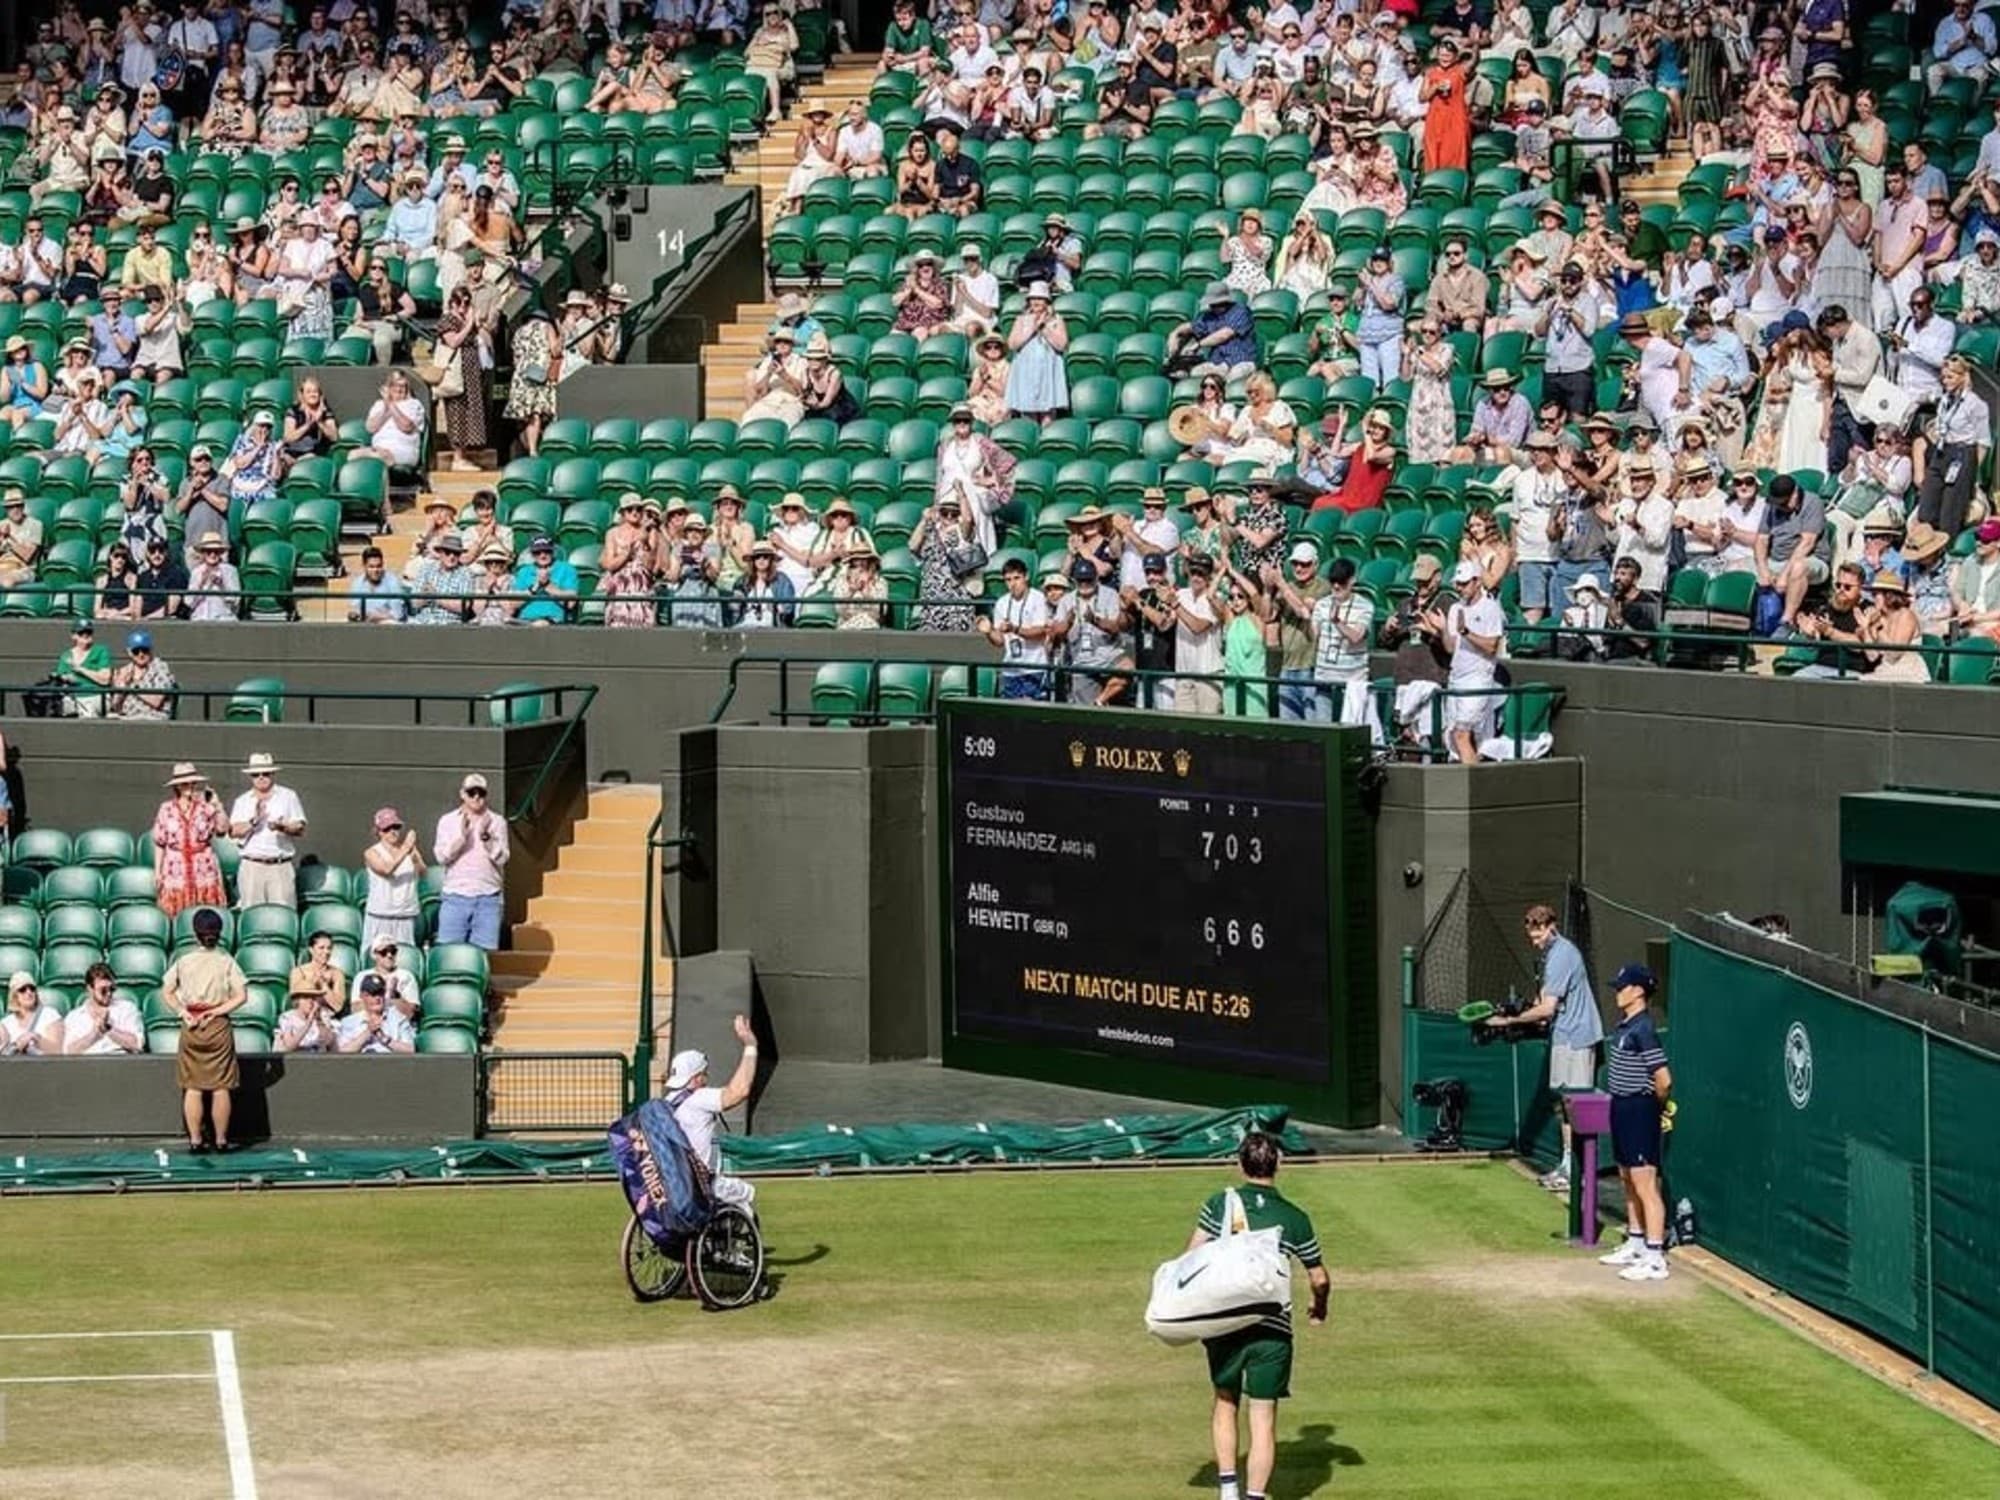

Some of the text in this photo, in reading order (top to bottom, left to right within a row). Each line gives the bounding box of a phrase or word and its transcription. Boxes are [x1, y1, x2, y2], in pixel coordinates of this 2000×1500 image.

[657, 229, 684, 256] 14
[964, 736, 996, 757] 5:09
[1095, 746, 1165, 773] ROLEX
[966, 801, 1025, 824] Gustavo
[1228, 804, 1235, 816] 2
[966, 826, 1057, 853] FERNANDEZ
[1201, 831, 1215, 858] 7
[1226, 833, 1239, 860] 0
[1249, 837, 1262, 864] 3
[967, 881, 1000, 903] Alfie
[968, 907, 1031, 931] HEWETT
[1203, 916, 1216, 943] 6
[1227, 919, 1240, 946] 6
[1251, 922, 1265, 950] 6
[1023, 967, 1251, 1018] NEXT MATCH DUE AT 5:26
[1097, 1026, 1174, 1048] wimbledon.com
[640, 1153, 667, 1211] YONEX
